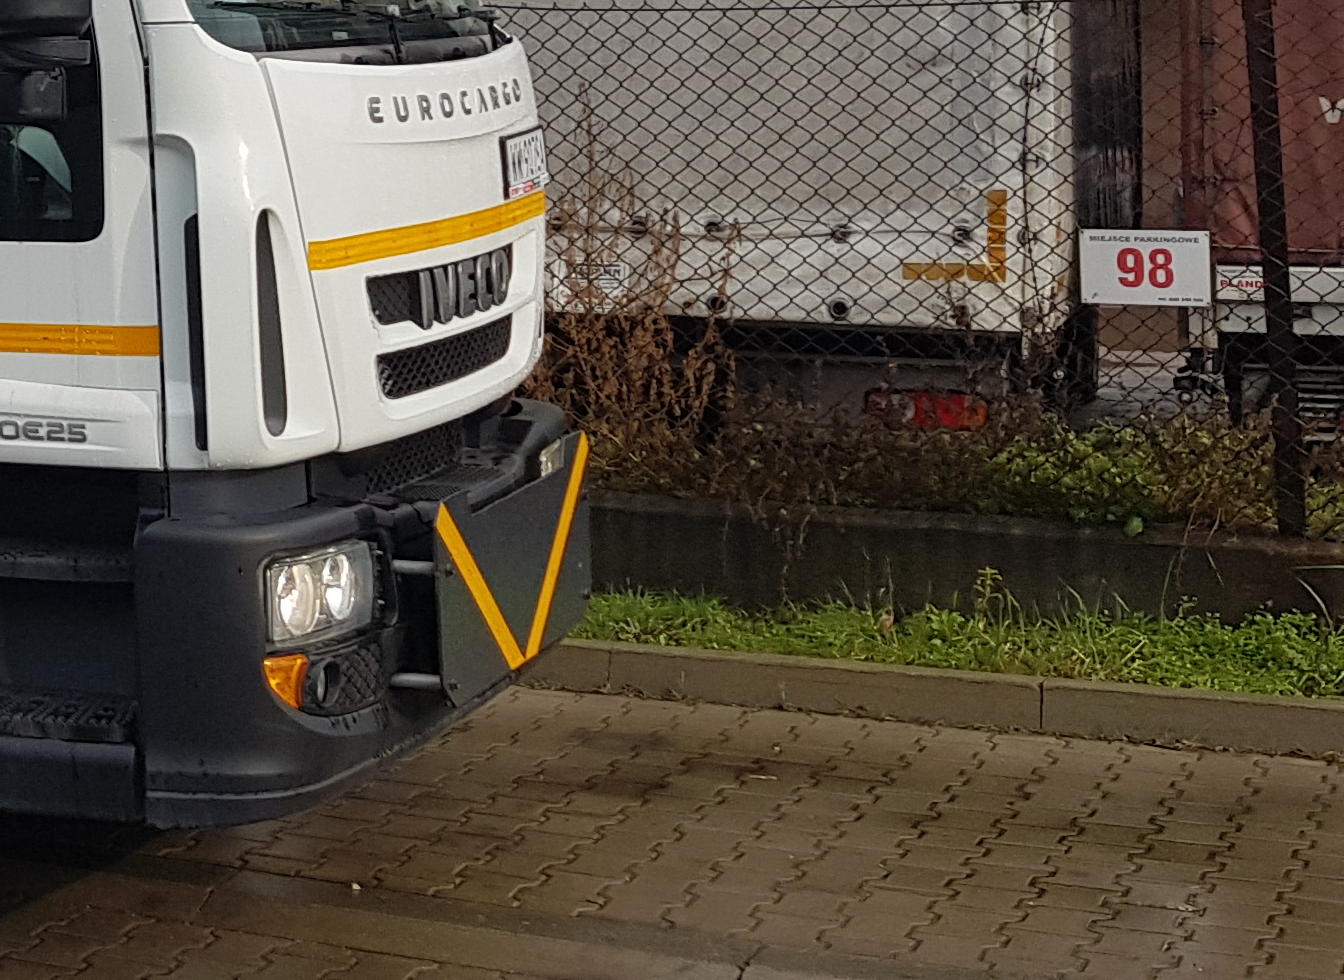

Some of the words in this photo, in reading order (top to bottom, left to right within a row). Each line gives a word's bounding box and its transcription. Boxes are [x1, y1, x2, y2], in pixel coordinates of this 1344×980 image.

[367, 78, 522, 124] EUROCARGO
[418, 249, 510, 331] IVECO
[1116, 247, 1174, 289] 98
